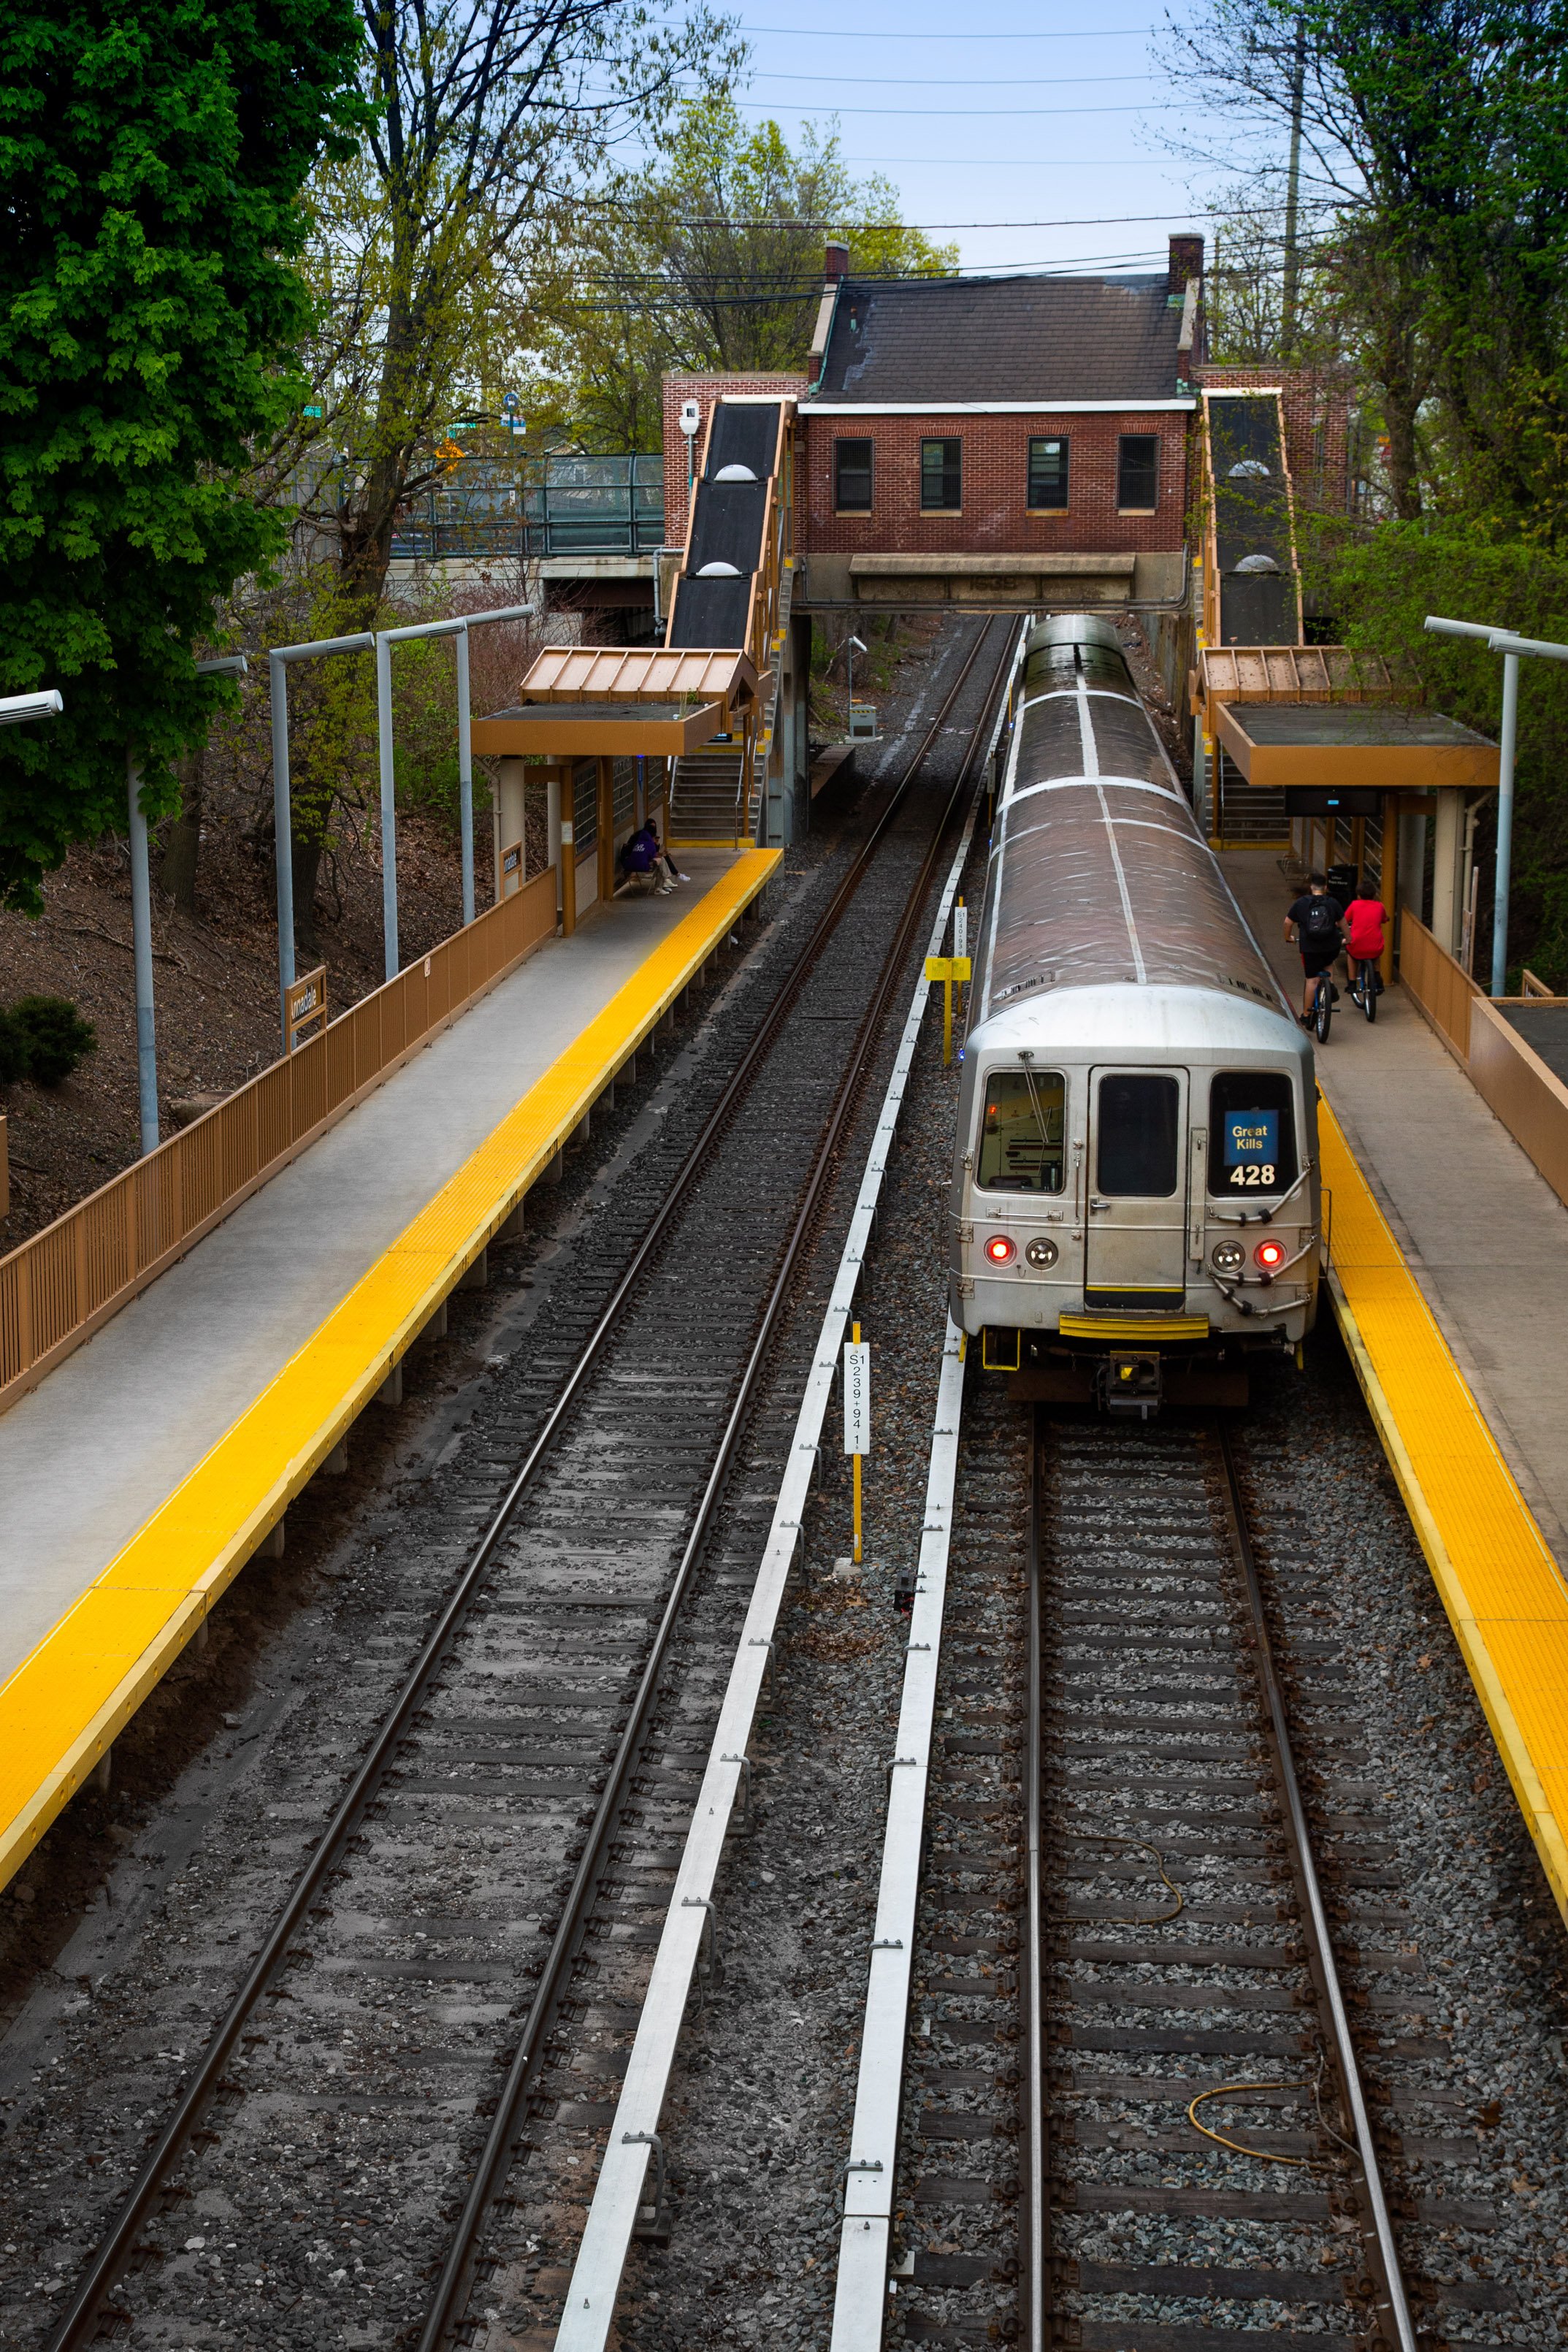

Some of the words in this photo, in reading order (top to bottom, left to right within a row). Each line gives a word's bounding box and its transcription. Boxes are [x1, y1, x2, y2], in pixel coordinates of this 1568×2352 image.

[1232, 1125, 1267, 1137] Great
[1236, 1139, 1263, 1150] Kills
[1230, 1164, 1275, 1185] 428
[849, 1354, 865, 1364] S1
